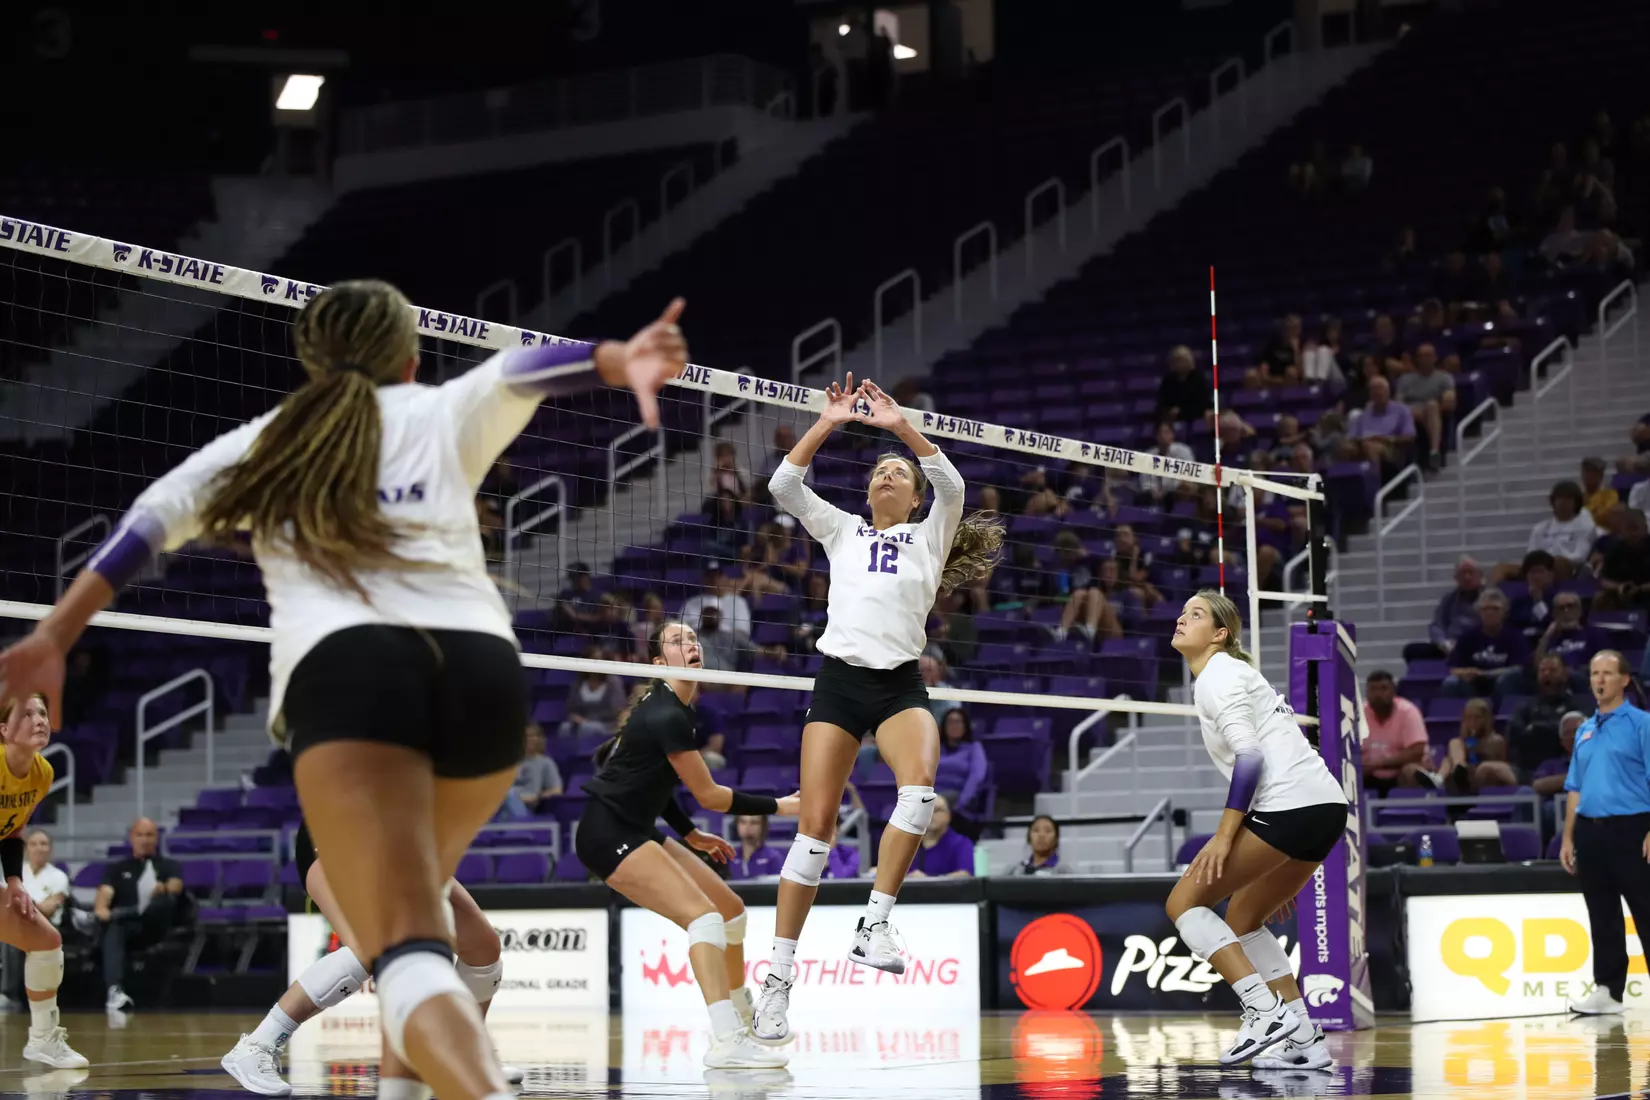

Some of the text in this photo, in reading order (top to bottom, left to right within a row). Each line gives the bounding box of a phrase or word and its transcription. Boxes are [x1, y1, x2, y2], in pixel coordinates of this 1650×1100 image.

[138, 249, 224, 284] K-STATE
[418, 309, 490, 340] K-STATE
[677, 365, 711, 385] ATE
[755, 379, 810, 405] K-STATE
[936, 415, 984, 438] K-STATE
[1018, 431, 1062, 453] K-STATE
[1093, 446, 1135, 466] K-STATE
[1163, 458, 1202, 478] K-STATE
[868, 541, 898, 575] 12
[1339, 693, 1365, 958] K-STATE
[1313, 864, 1330, 963] sports imports
[496, 928, 588, 952] o.com
[546, 978, 588, 990] GRADE
[1523, 980, 1643, 998] MEXC
